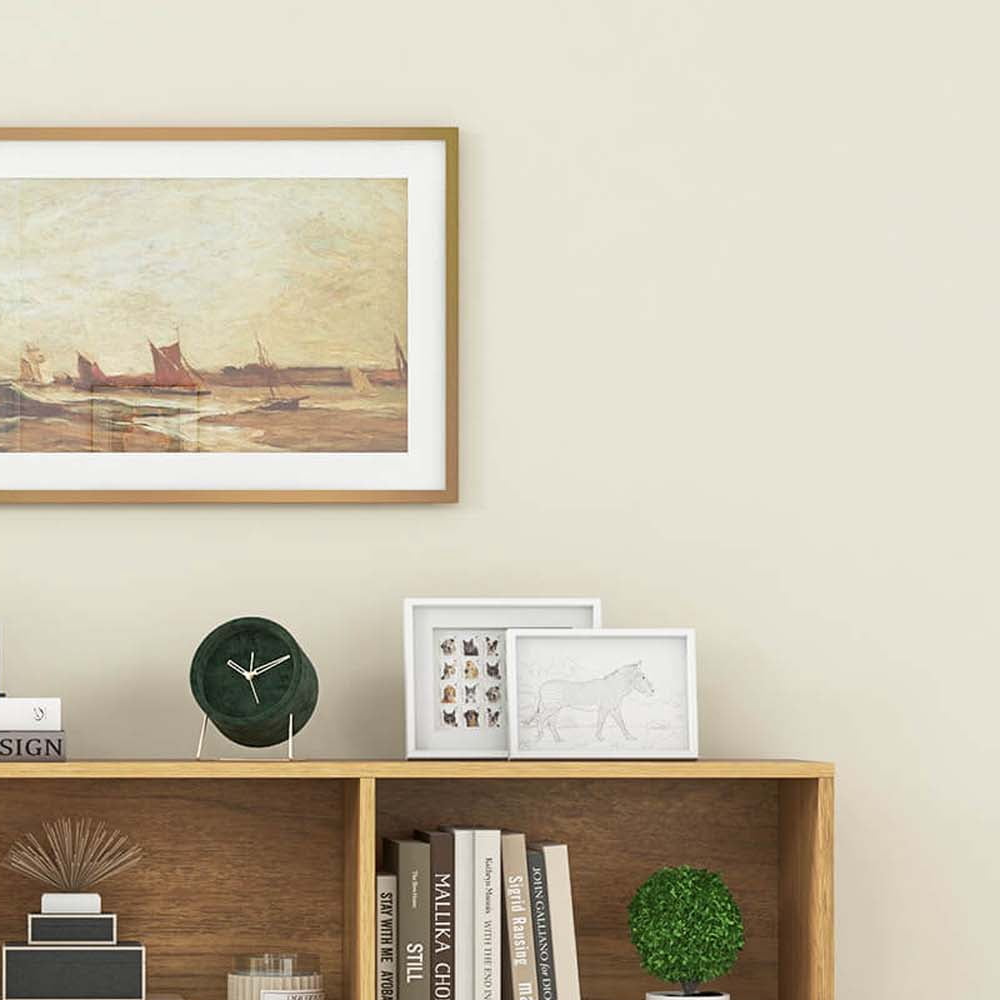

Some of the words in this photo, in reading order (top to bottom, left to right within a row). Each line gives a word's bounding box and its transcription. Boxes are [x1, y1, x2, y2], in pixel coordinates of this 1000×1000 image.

[507, 875, 524, 912] Sigrid
[532, 866, 544, 899] JOHN
[380, 892, 393, 916] STAY
[434, 873, 451, 953] MALLIKA
[380, 919, 393, 946] WITH
[483, 920, 492, 947] WITH
[511, 917, 529, 966] Rausing
[535, 900, 550, 961] GALLIANO
[380, 948, 393, 962] ME
[406, 943, 424, 983] STILL
[483, 948, 492, 965] THE
[483, 966, 492, 988] END
[540, 962, 550, 977] for
[483, 989, 492, 1000] IN
